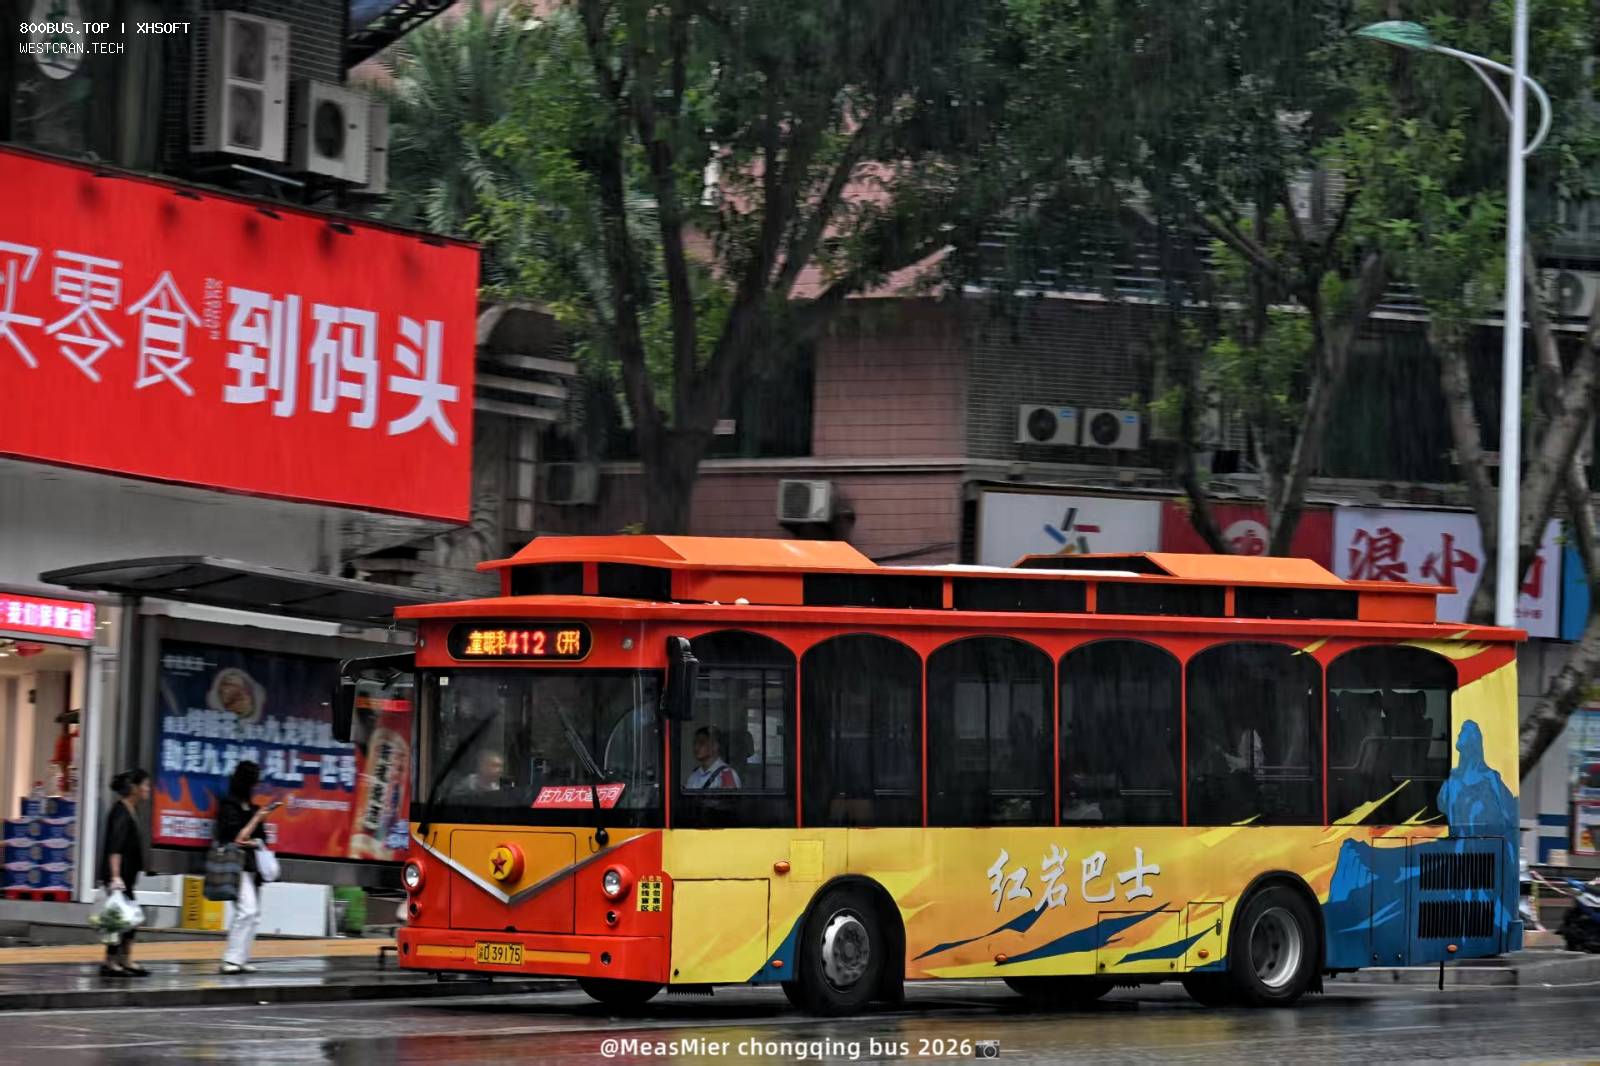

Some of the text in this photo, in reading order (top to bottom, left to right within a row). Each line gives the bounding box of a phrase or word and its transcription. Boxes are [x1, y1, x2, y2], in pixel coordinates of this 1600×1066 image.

[223, 286, 458, 446] 到码头
[987, 844, 1161, 912] 红岩巴士
